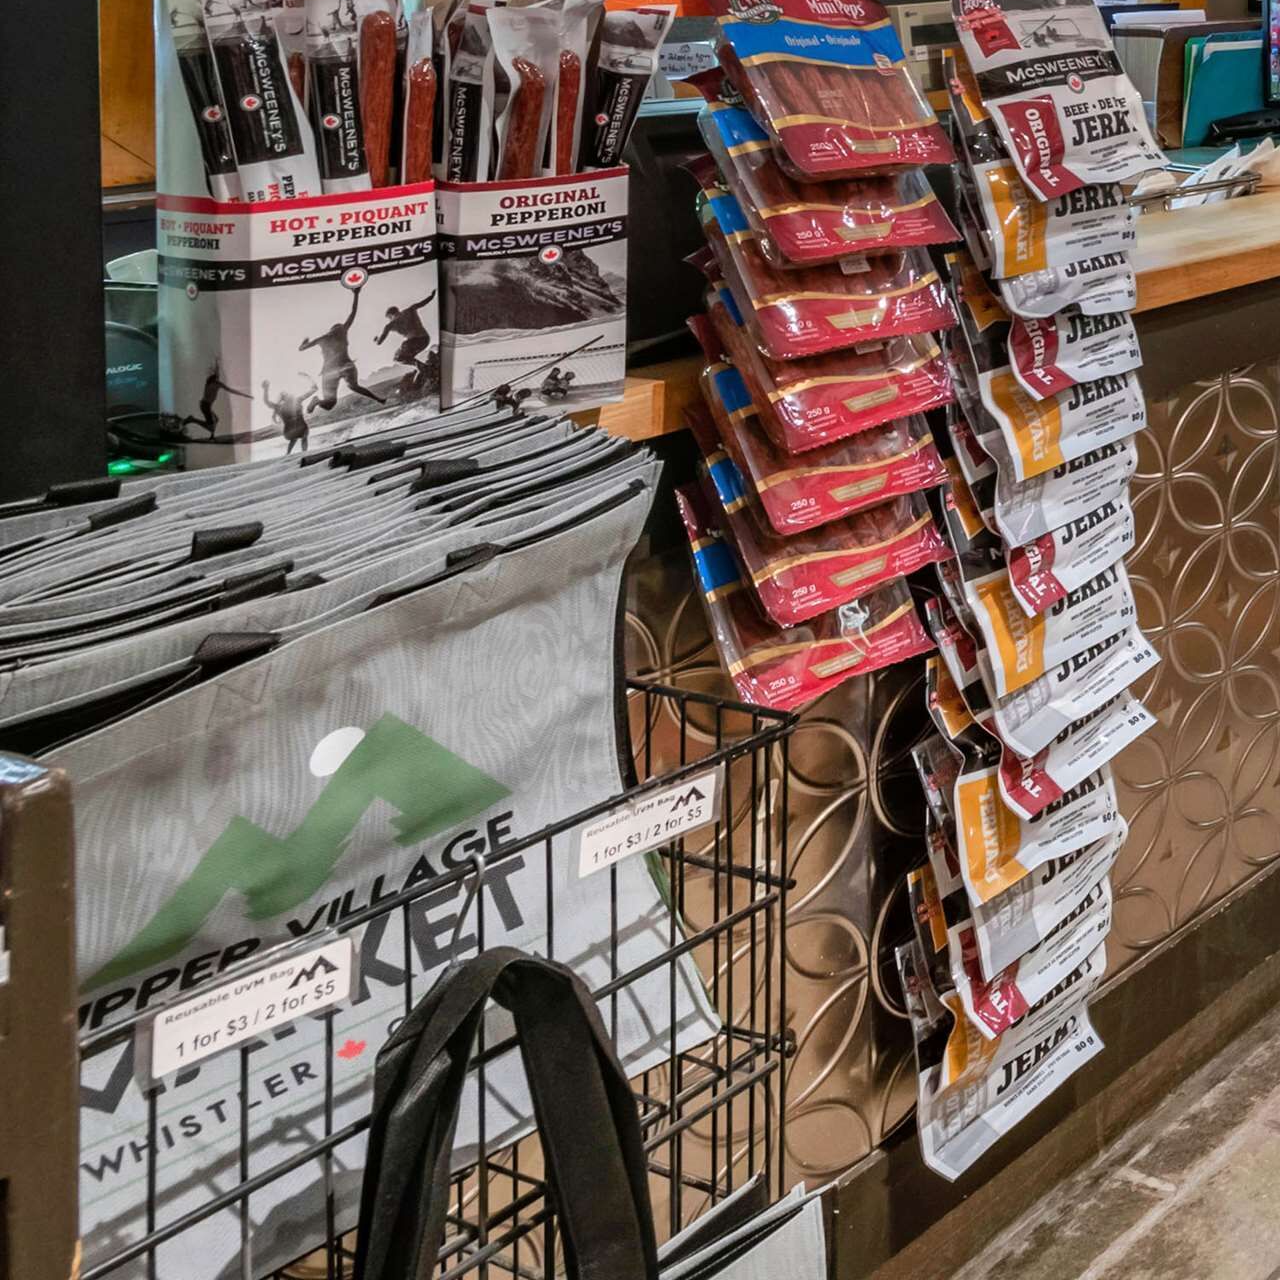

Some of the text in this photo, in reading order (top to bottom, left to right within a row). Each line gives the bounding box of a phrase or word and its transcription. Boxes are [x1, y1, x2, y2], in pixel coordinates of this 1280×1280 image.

[338, 67, 360, 171] McSWEENEY'S
[1063, 101, 1089, 118] BEEF
[1025, 108, 1060, 187] ORIGINAL
[491, 201, 607, 226] PEPPERONI
[500, 187, 600, 210] ORIGINAL
[184, 223, 235, 235] PIQUANT
[270, 201, 429, 233] HOT PIQUANT
[293, 220, 412, 247] PEPPERONI
[167, 236, 220, 250] PEPPERONI
[467, 221, 623, 252] McSWEENEY'S
[260, 240, 432, 278] McSWEENEY'S
[592, 852, 599, 864] 1
[604, 843, 623, 857] for
[626, 832, 642, 849] $3
[653, 824, 661, 837] 2
[665, 816, 683, 831] for
[687, 805, 702, 822] $5
[286, 810, 515, 940] VILLAGE
[165, 966, 295, 1025] Reusable UVM Bag
[176, 1041, 186, 1057] 1
[192, 1029, 220, 1051] for
[226, 1015, 249, 1037] $3
[265, 1003, 277, 1020] 2
[282, 992, 308, 1013] for
[314, 979, 336, 1001] $5
[82, 1060, 320, 1182] WHISTLER
